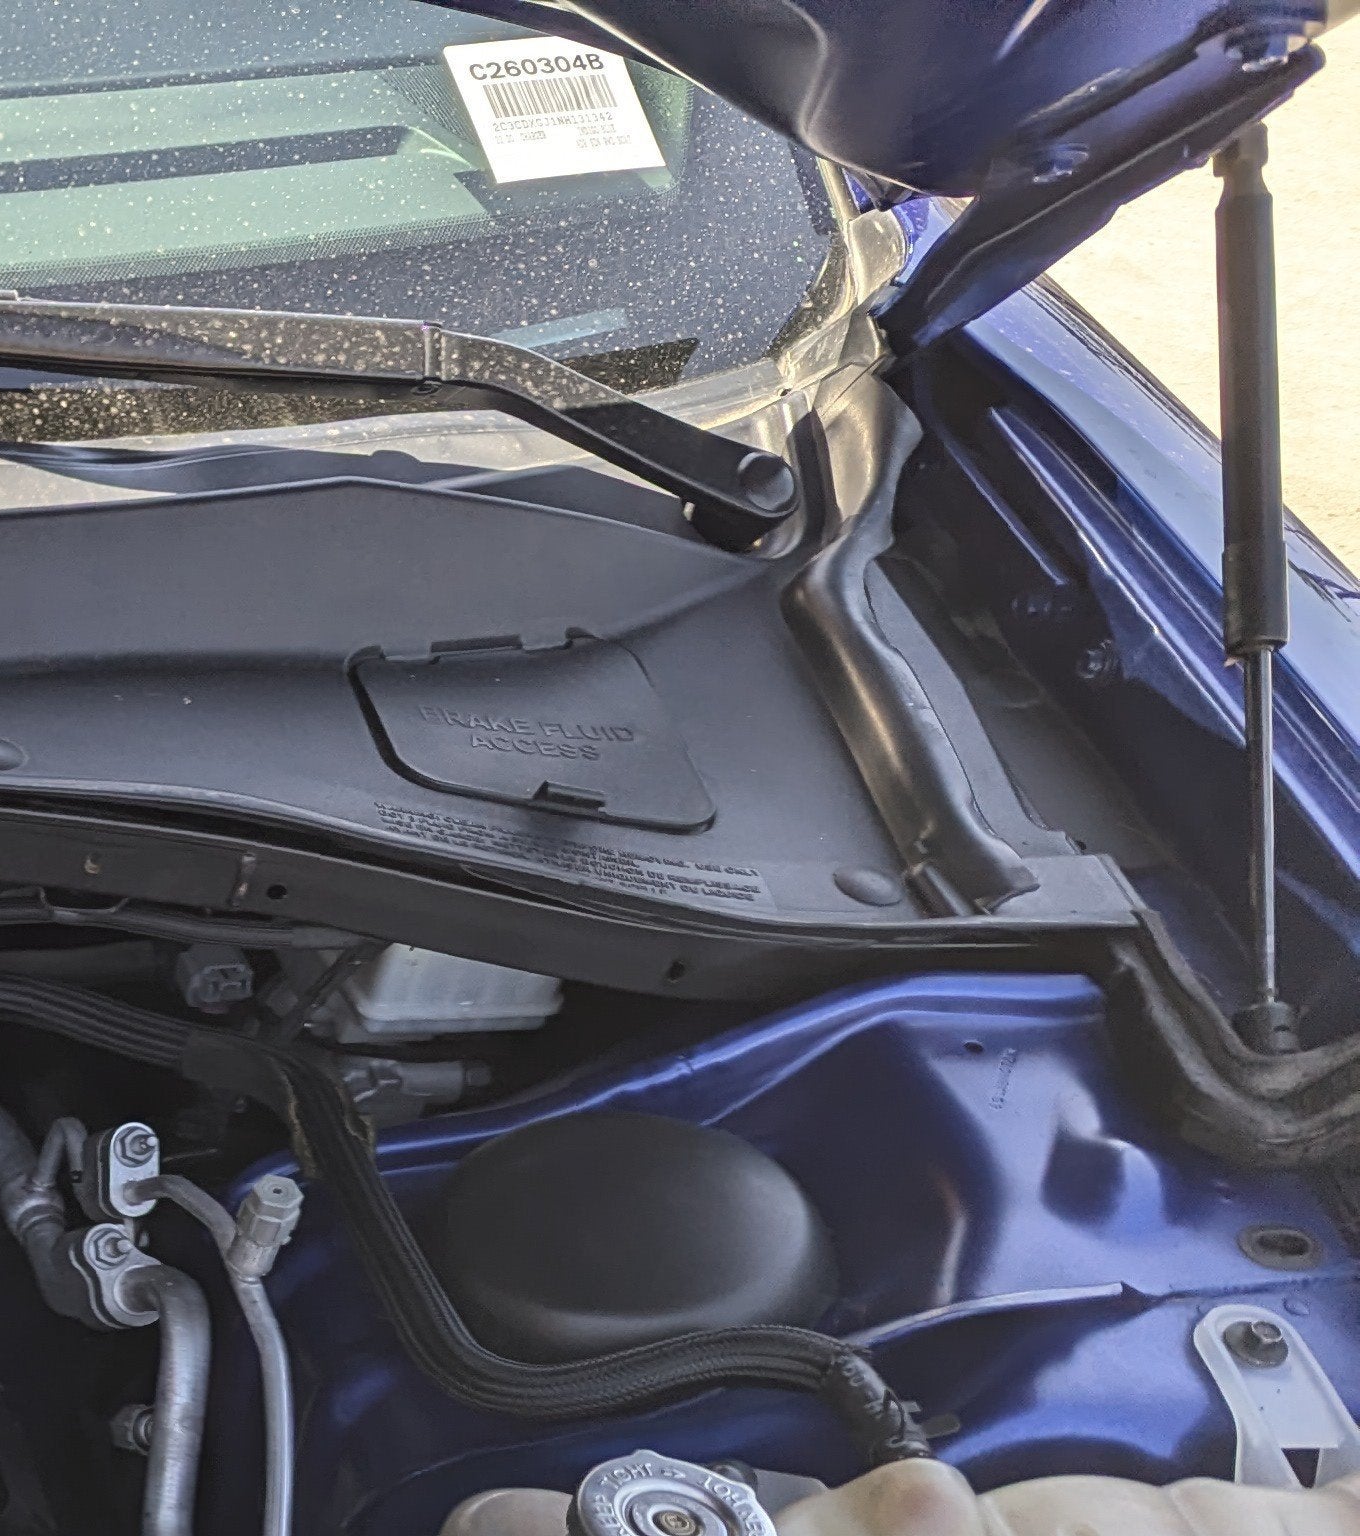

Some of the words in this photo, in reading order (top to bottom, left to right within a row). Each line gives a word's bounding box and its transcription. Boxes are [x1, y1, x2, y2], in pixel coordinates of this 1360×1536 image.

[469, 53, 605, 81] C260304B
[419, 706, 534, 737] BRAKE
[538, 720, 635, 743] FLUID
[470, 732, 601, 761] ACCESS
[600, 1462, 653, 1490] TIGHT
